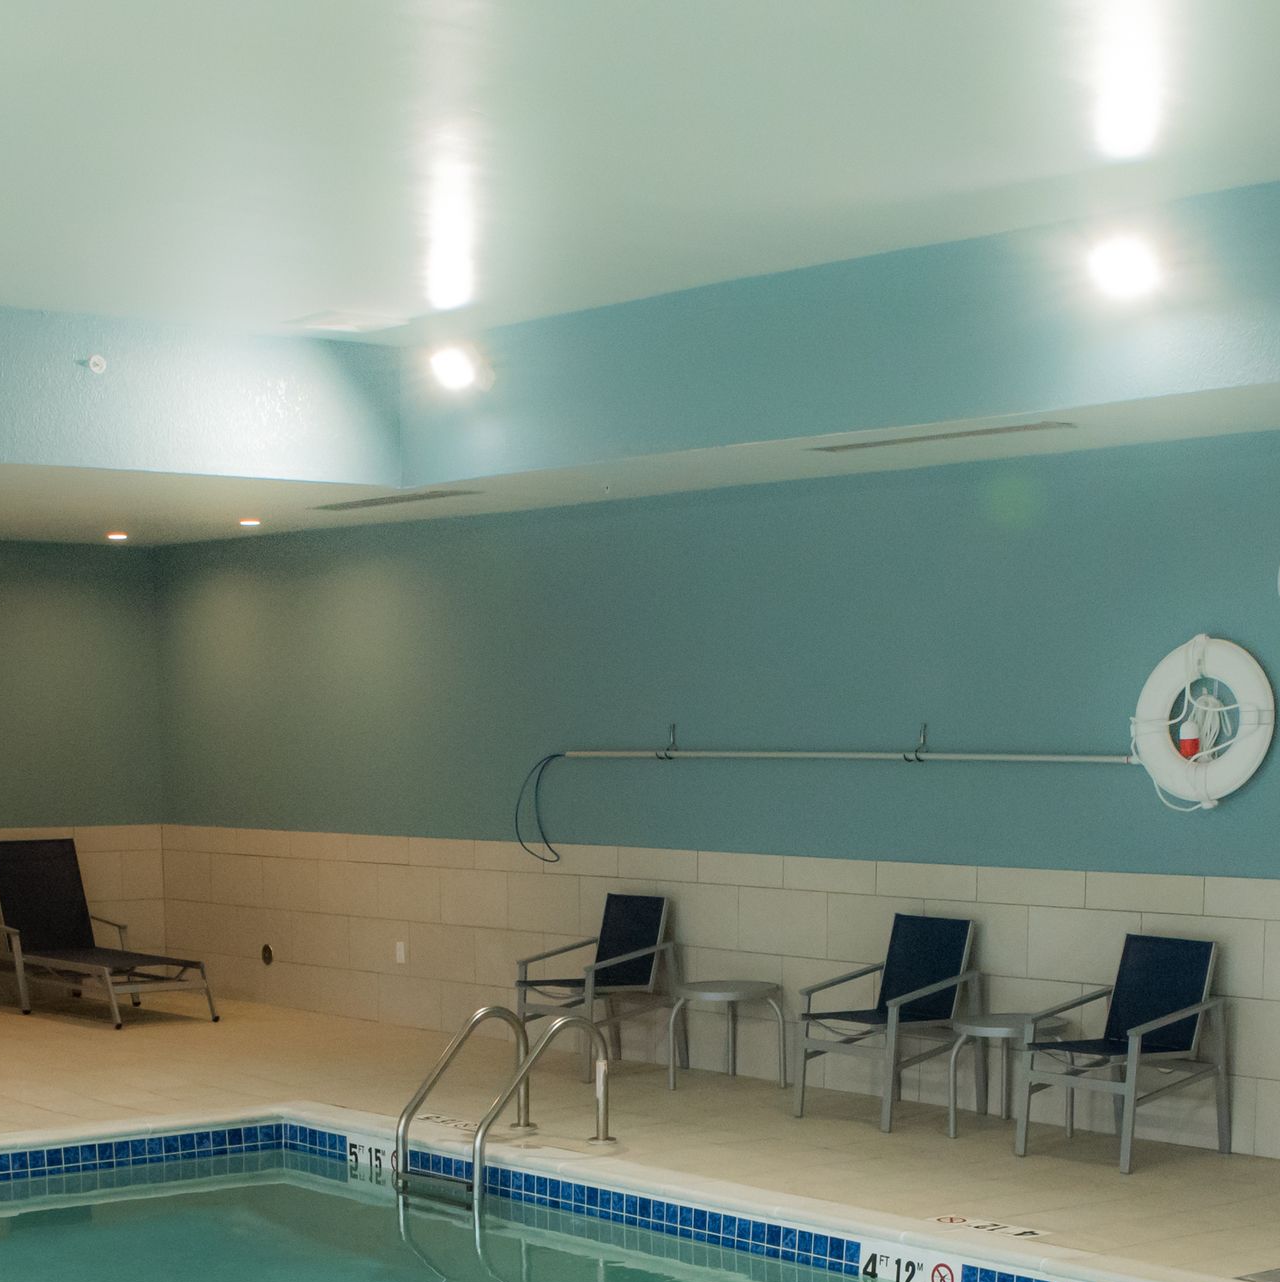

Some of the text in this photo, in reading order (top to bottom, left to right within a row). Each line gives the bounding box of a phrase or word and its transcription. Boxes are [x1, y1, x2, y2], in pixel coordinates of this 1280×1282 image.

[349, 1143, 358, 1163] 5
[862, 1253, 878, 1279] 4
[879, 1255, 890, 1268] FT
